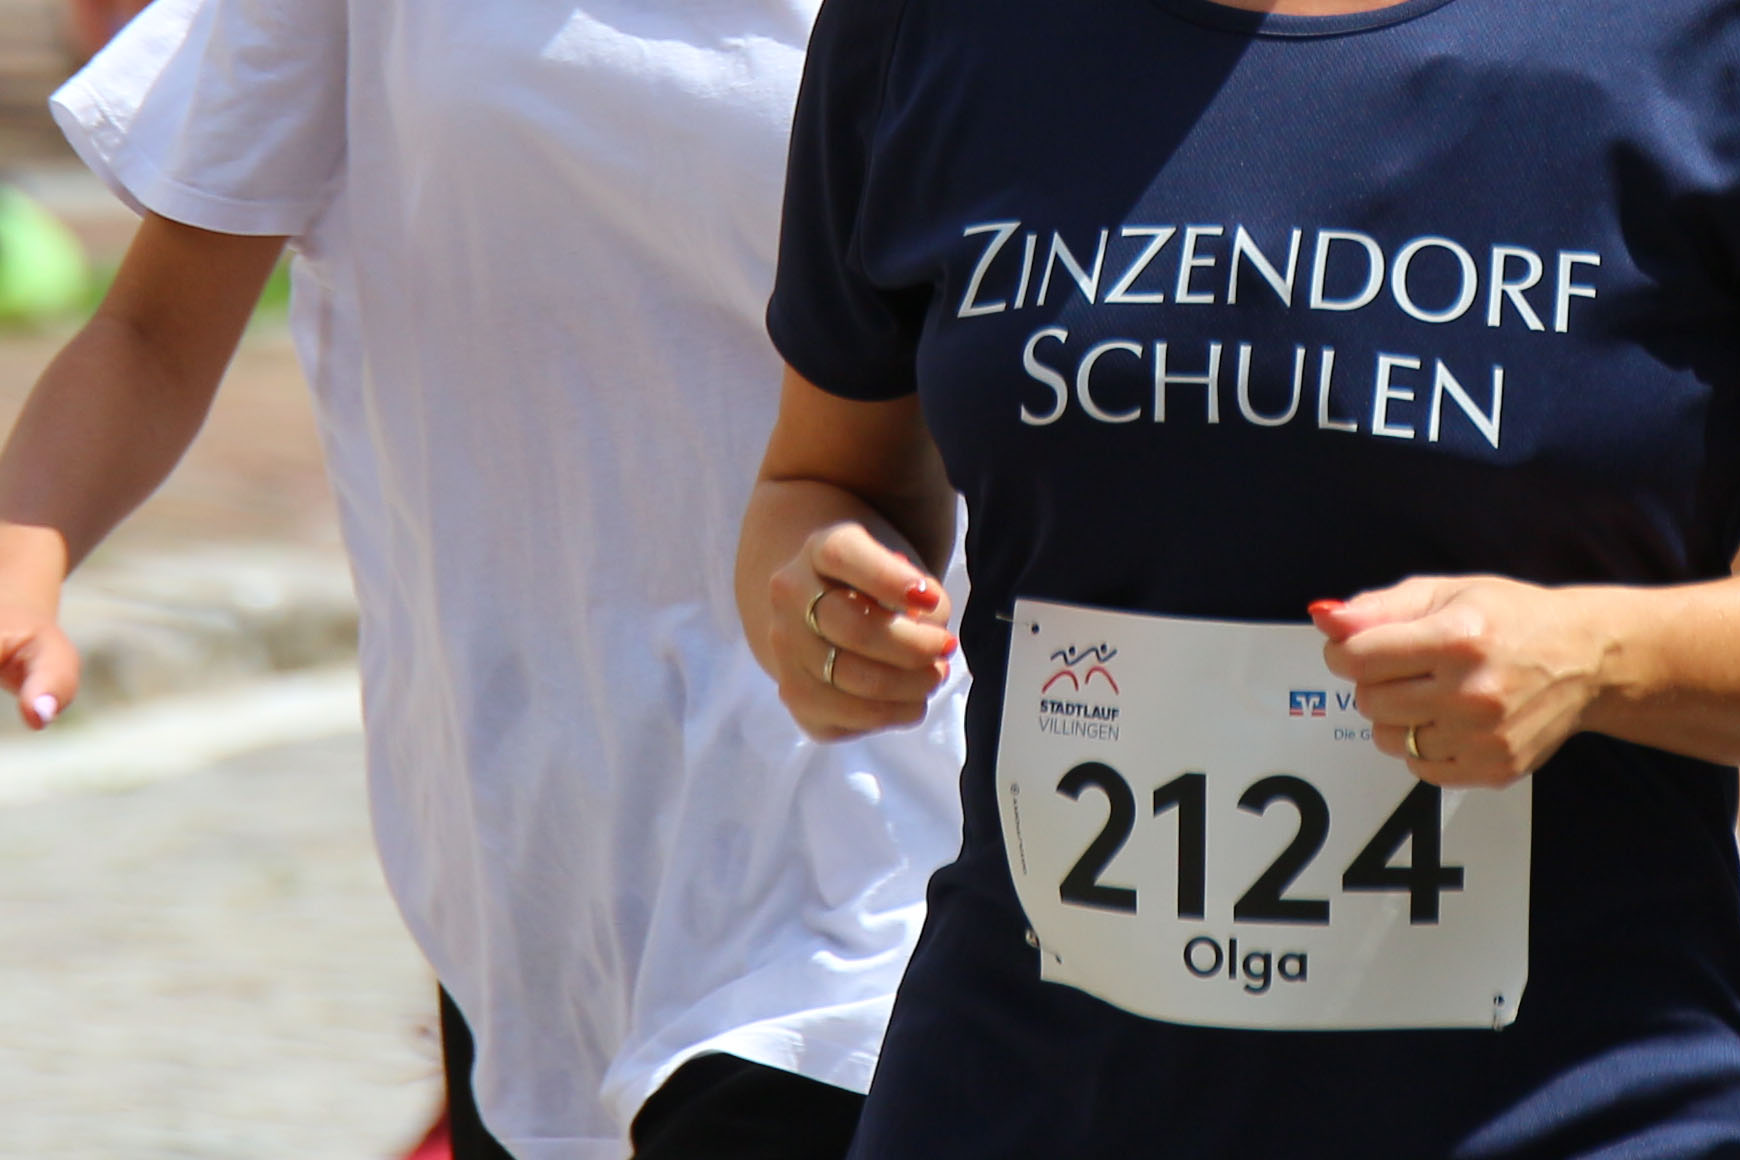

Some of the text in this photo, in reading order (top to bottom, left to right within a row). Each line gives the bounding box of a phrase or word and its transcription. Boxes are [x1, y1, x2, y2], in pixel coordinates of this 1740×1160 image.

[956, 220, 1600, 334] ZINZENDORF
[1020, 328, 1504, 449] SCHULEN
[1039, 716, 1119, 741] VILLINGEN
[1040, 699, 1119, 721] STADTLAUF
[1334, 728, 1355, 741] Die
[1056, 760, 1464, 926] 2124
[1183, 936, 1308, 994] Olga
